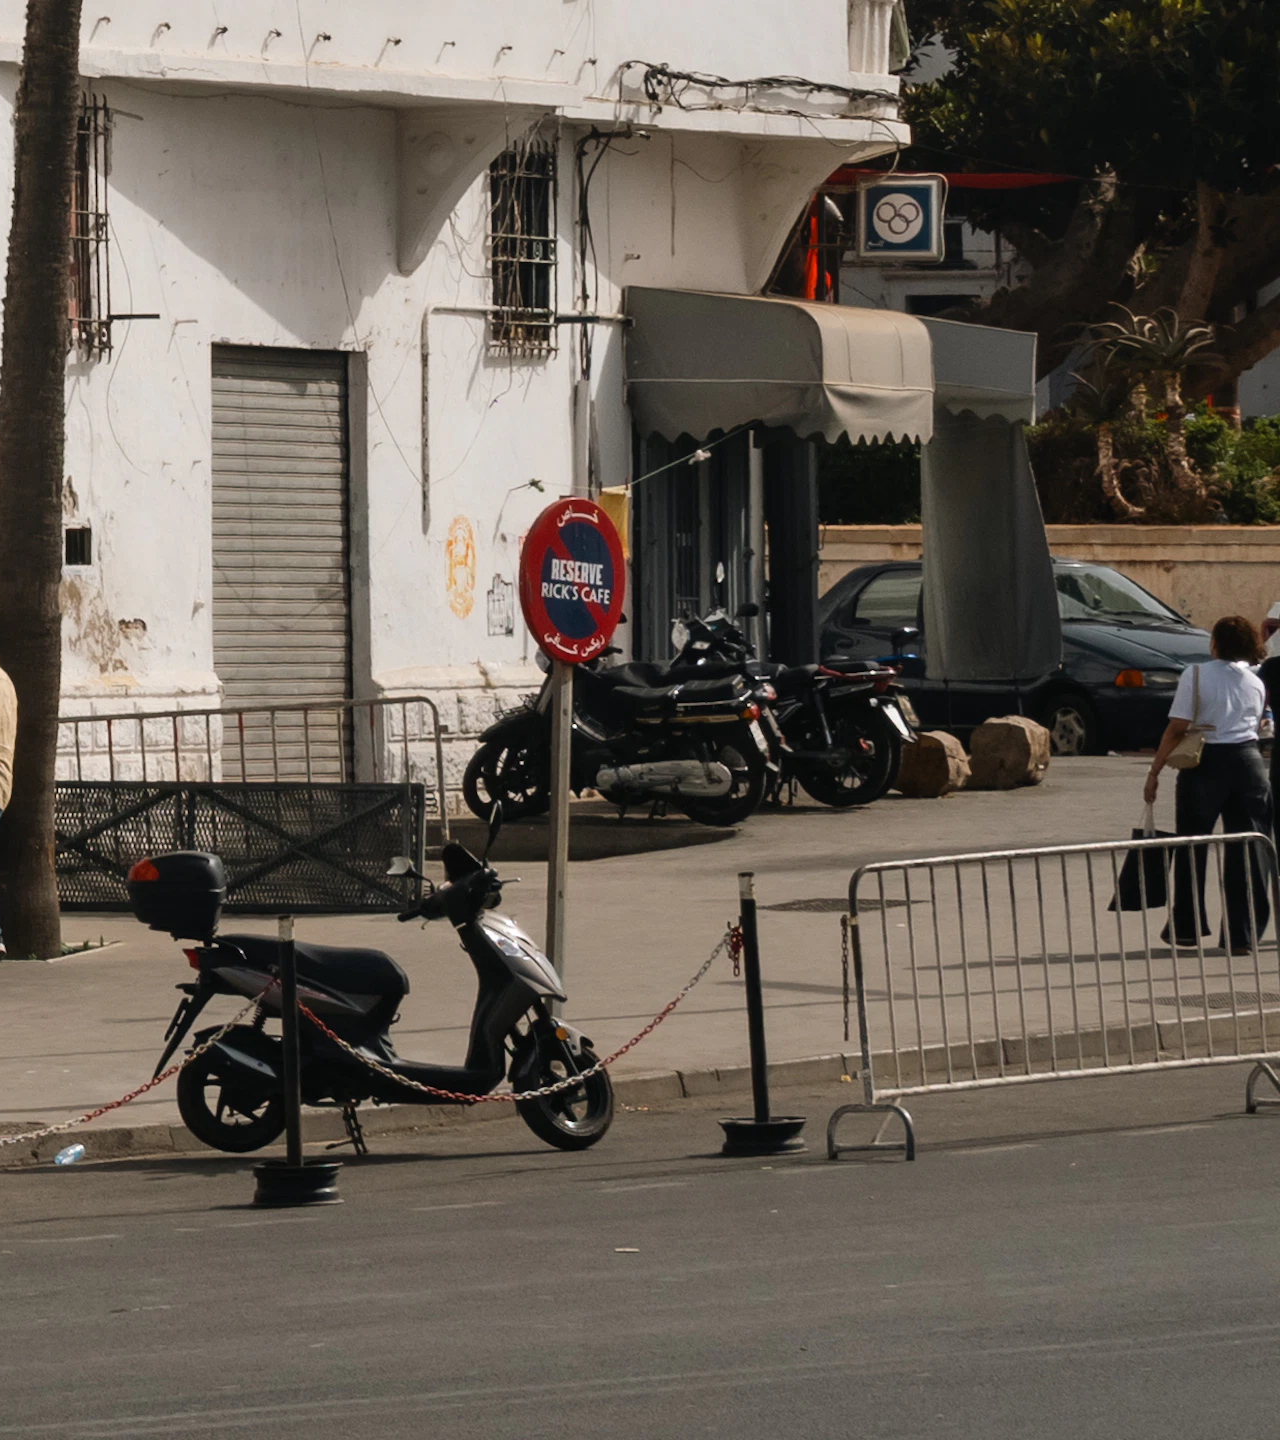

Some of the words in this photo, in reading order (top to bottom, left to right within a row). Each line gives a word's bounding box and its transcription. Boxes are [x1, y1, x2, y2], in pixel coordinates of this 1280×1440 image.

[556, 504, 599, 528] خاص
[551, 558, 604, 586] RESERVE
[541, 582, 579, 601] RICK'S
[581, 586, 611, 605] CAFE
